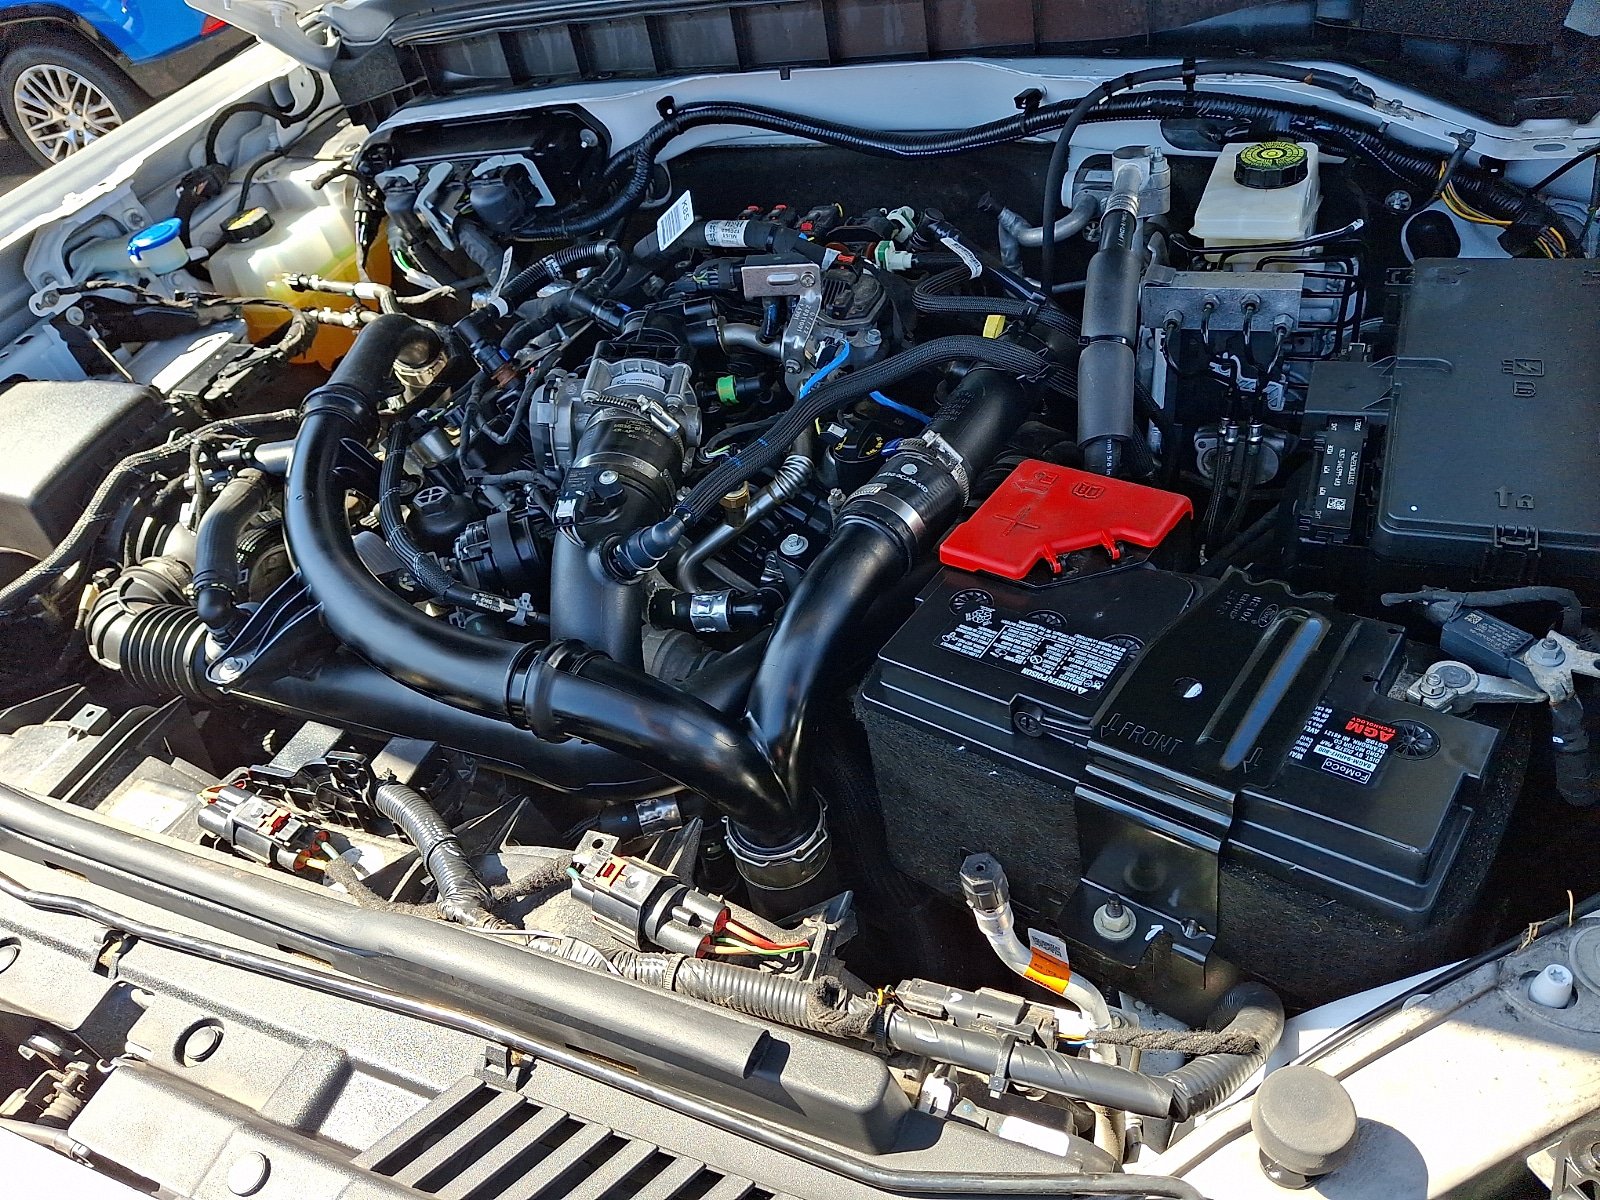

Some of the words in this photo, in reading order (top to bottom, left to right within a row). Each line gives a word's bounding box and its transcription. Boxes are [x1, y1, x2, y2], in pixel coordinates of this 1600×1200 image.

[1345, 721, 1395, 742] AGM
[1351, 716, 1397, 733] TECHNOLOGY
[1117, 721, 1184, 755] FRONT
[1342, 742, 1365, 752] MOTOR
[1325, 760, 1369, 781] FoMoCo
